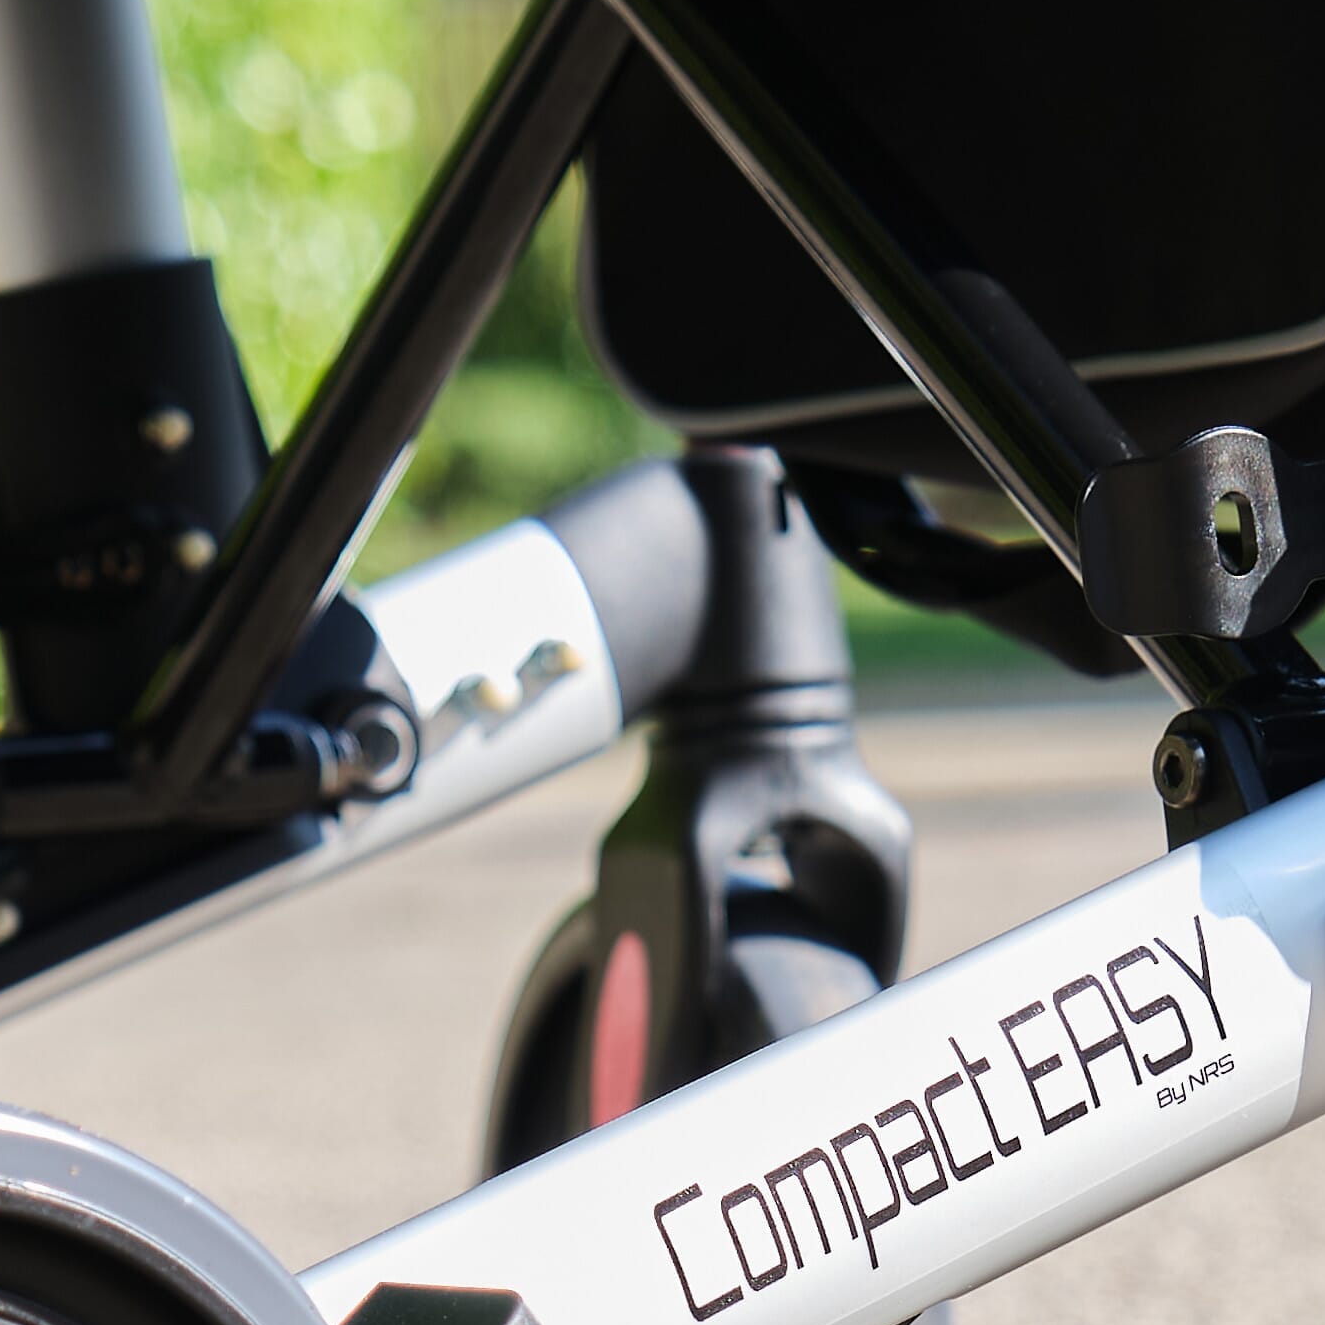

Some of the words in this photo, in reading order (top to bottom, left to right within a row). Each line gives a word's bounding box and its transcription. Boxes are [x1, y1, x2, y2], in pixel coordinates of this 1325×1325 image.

[653, 1036, 1022, 1323] Compact
[997, 914, 1227, 1137] EASY
[1156, 1081, 1187, 1109] By
[1188, 1053, 1235, 1093] NRS
